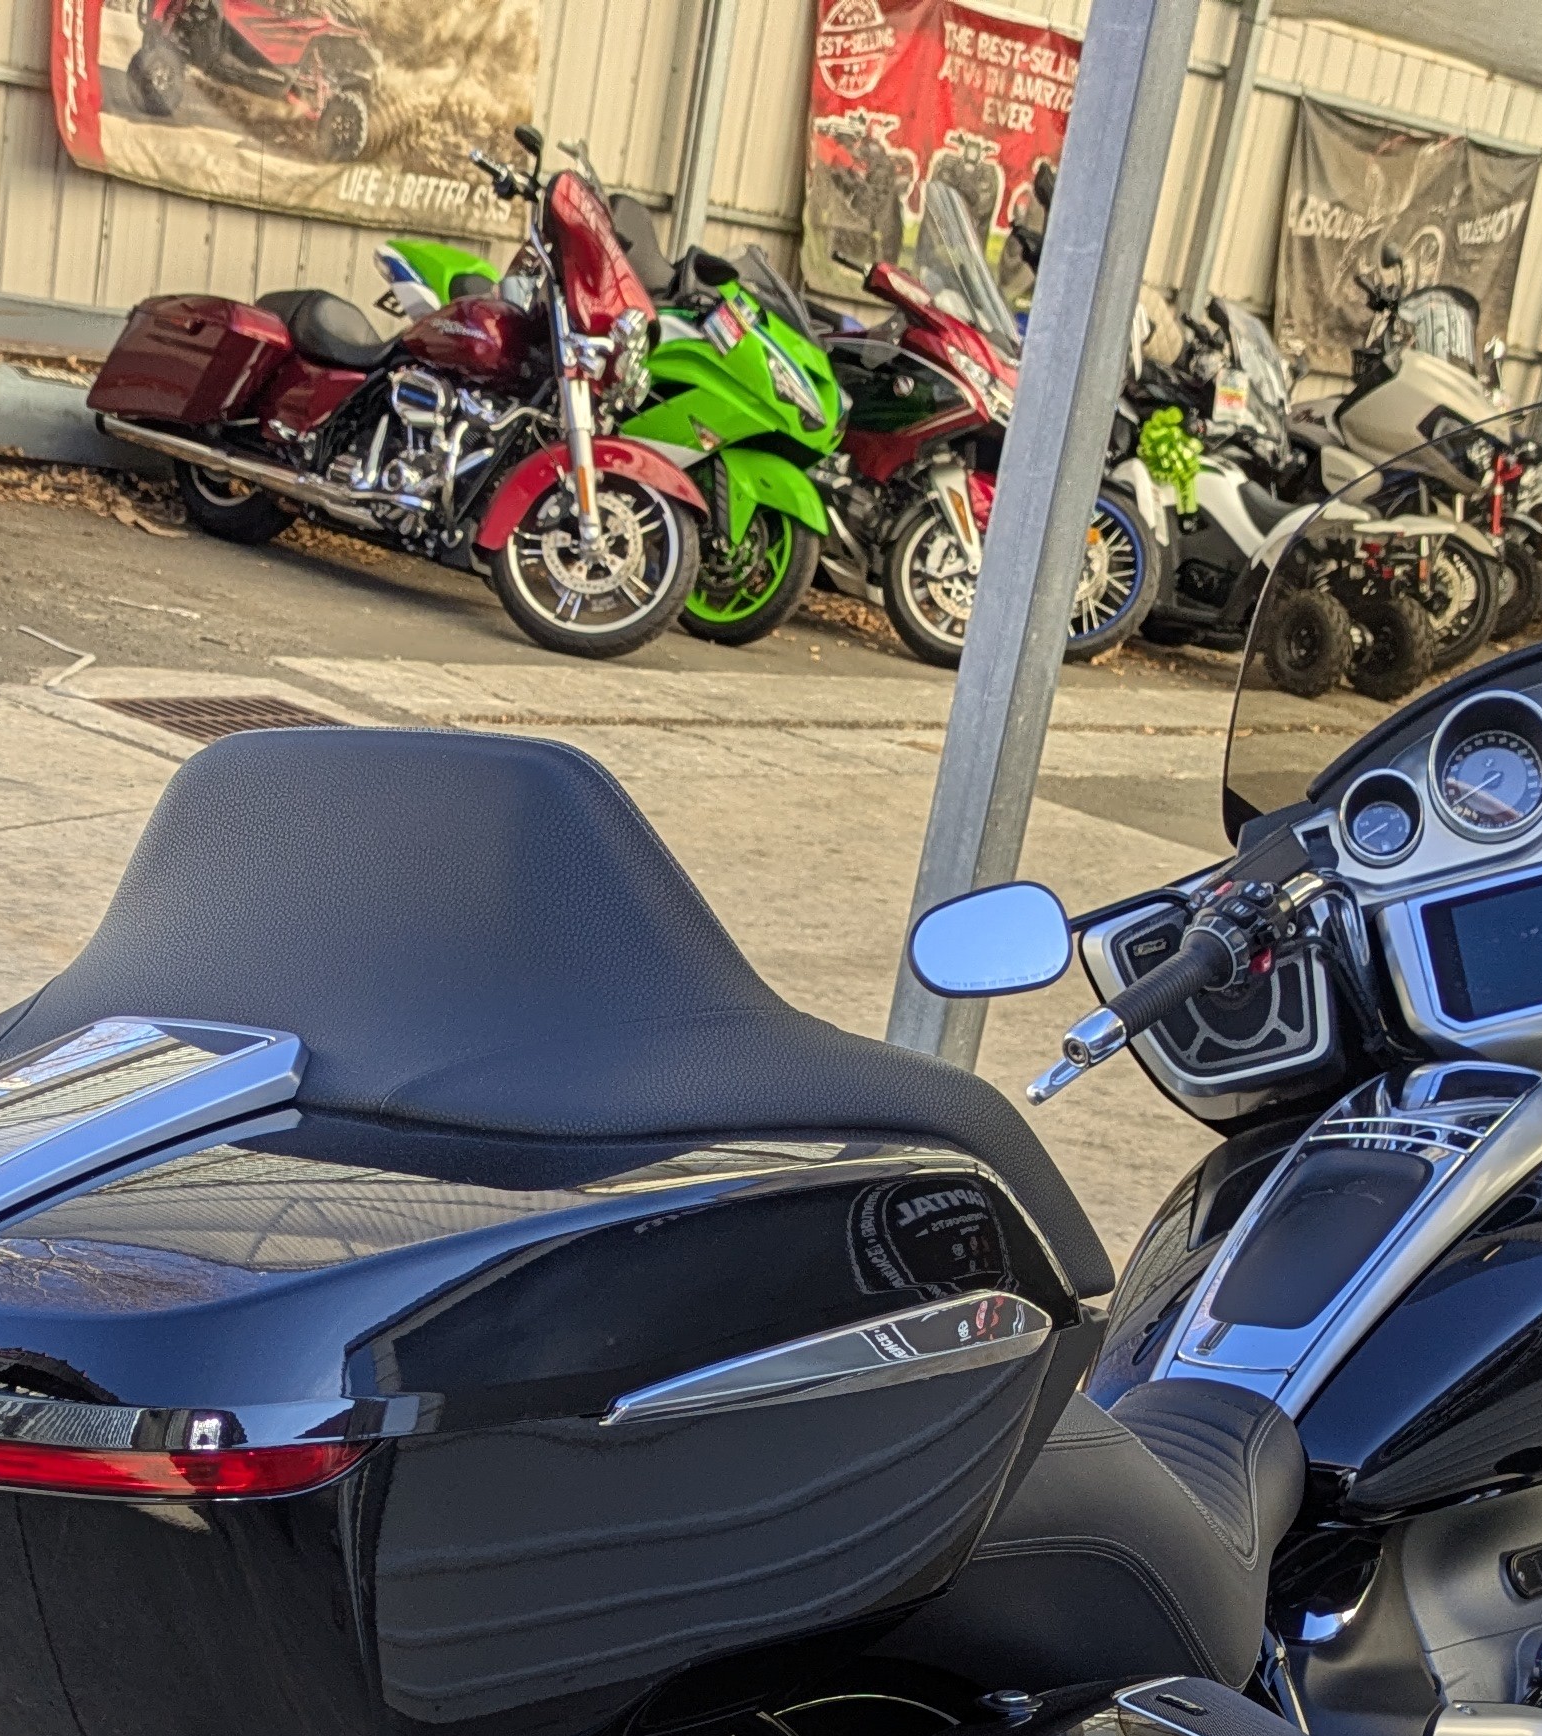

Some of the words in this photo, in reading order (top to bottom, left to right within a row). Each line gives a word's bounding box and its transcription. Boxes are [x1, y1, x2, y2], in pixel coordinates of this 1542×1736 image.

[944, 20, 976, 56] THE
[1010, 72, 1074, 113] AMERIC
[339, 165, 383, 207] LIFE
